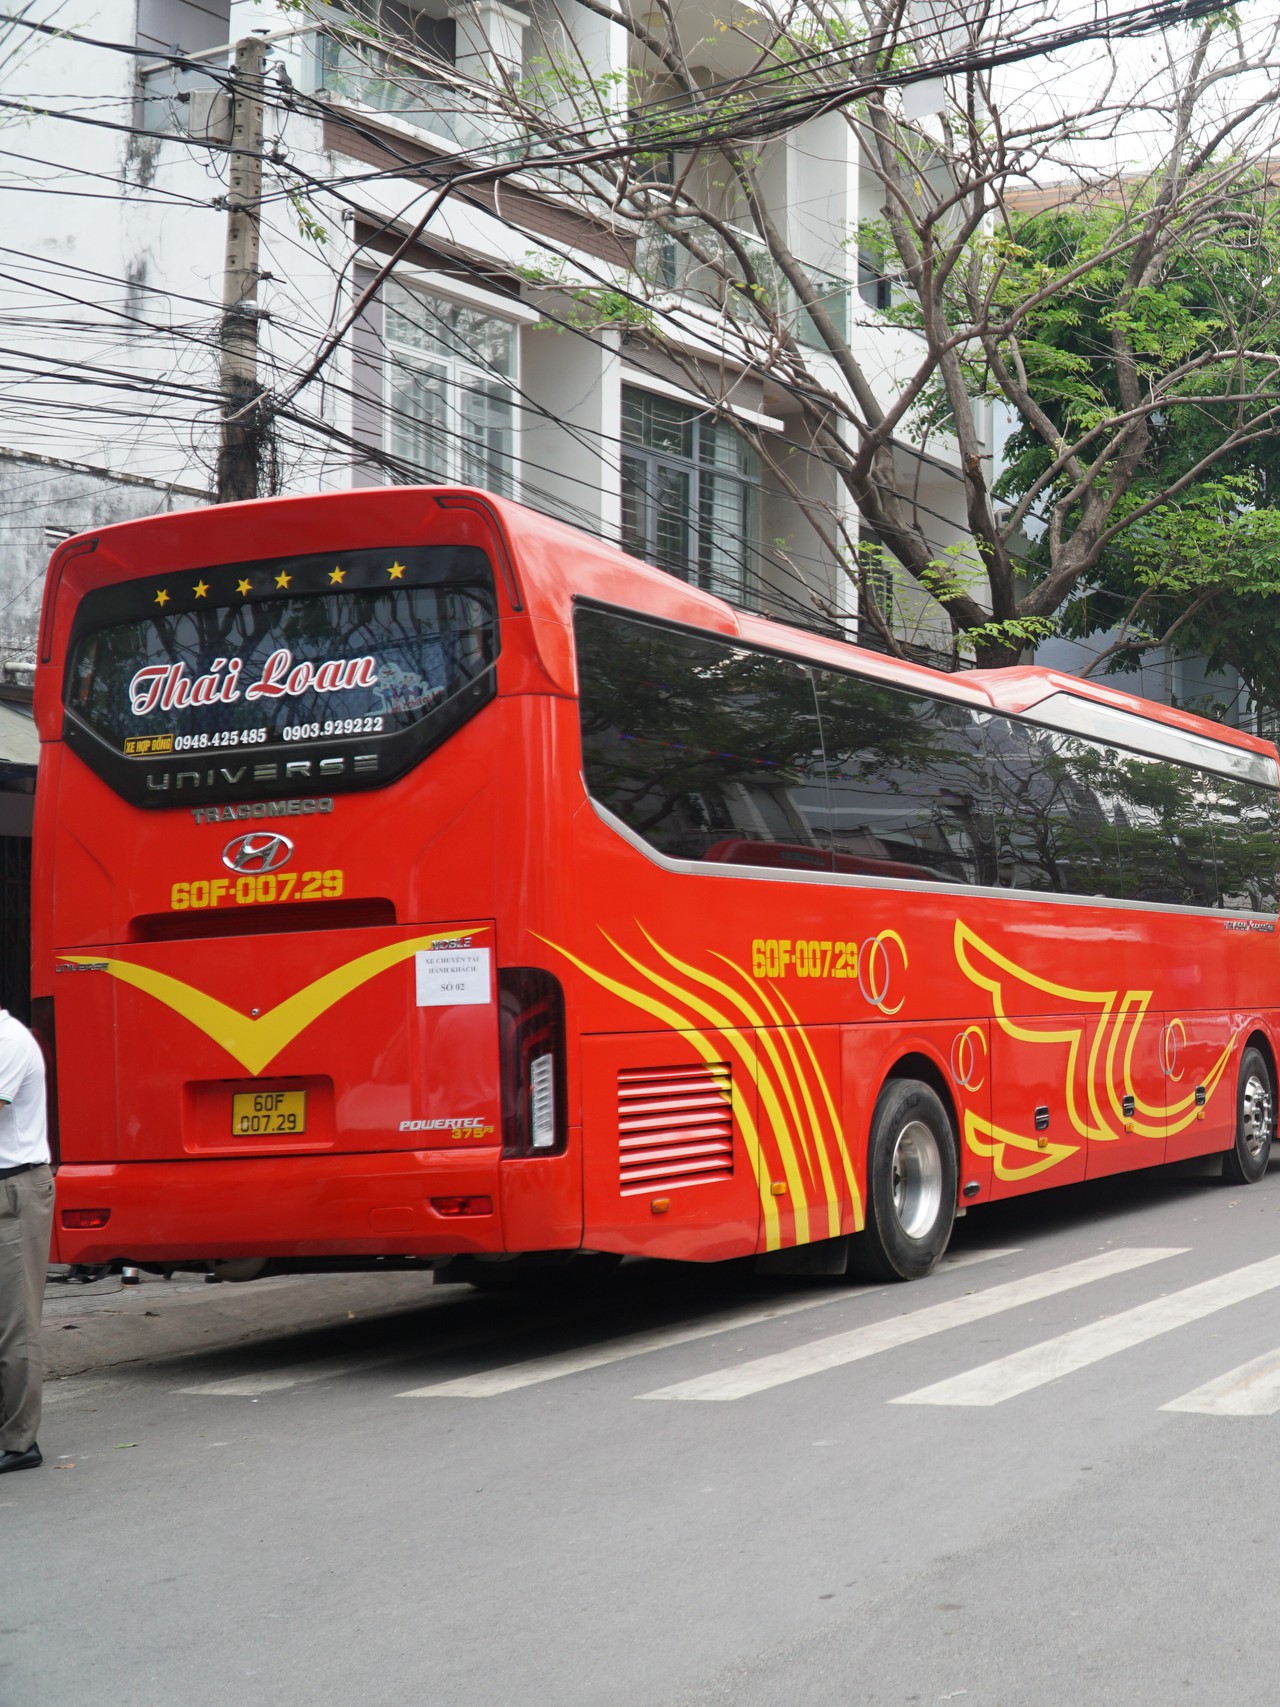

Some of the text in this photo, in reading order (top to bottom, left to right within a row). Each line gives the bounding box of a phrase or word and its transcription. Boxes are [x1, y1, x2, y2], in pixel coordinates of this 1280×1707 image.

[129, 648, 378, 716] Thái Loan
[282, 716, 384, 742] 0903.929222
[125, 741, 136, 754] XE
[136, 739, 151, 754] HỢP
[146, 754, 378, 790] UNIVERSE
[191, 797, 334, 825] TRACOMECO
[170, 869, 344, 910] 60F-007.29
[430, 937, 472, 950] NOBLE
[751, 938, 858, 979] 60F-007.29
[455, 983, 465, 991] 02
[254, 1094, 285, 1112] 60F
[240, 1113, 297, 1132] 007.29
[398, 1117, 485, 1132] POWERTEC
